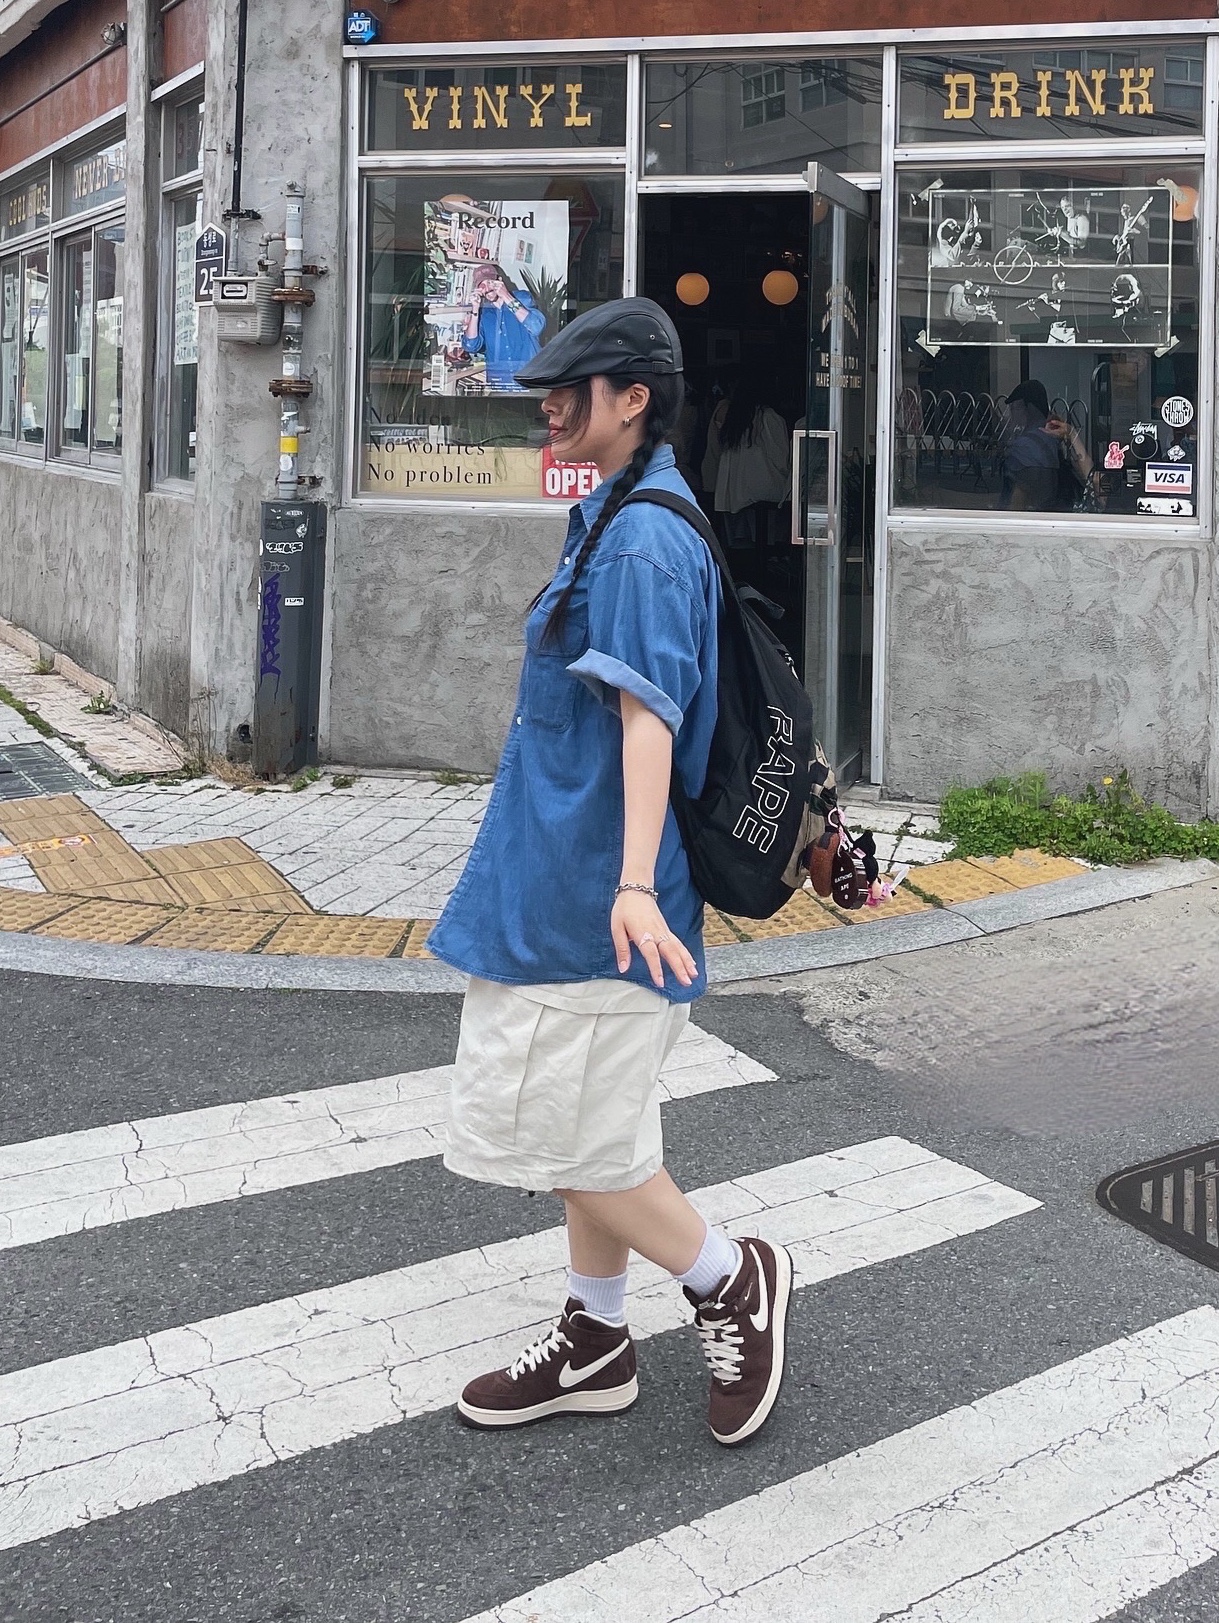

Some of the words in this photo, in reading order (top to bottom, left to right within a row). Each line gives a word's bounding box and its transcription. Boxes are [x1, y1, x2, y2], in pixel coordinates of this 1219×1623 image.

[349, 20, 371, 32] ADT
[943, 67, 1155, 119] DRINK
[404, 83, 592, 130] VINYL
[75, 155, 108, 199] NEVER
[457, 211, 536, 229] Record
[370, 406, 396, 425] No
[368, 435, 395, 453] No
[406, 440, 485, 456] worries
[367, 463, 394, 482] No
[406, 465, 493, 487] problem
[1153, 472, 1185, 484] VISA
